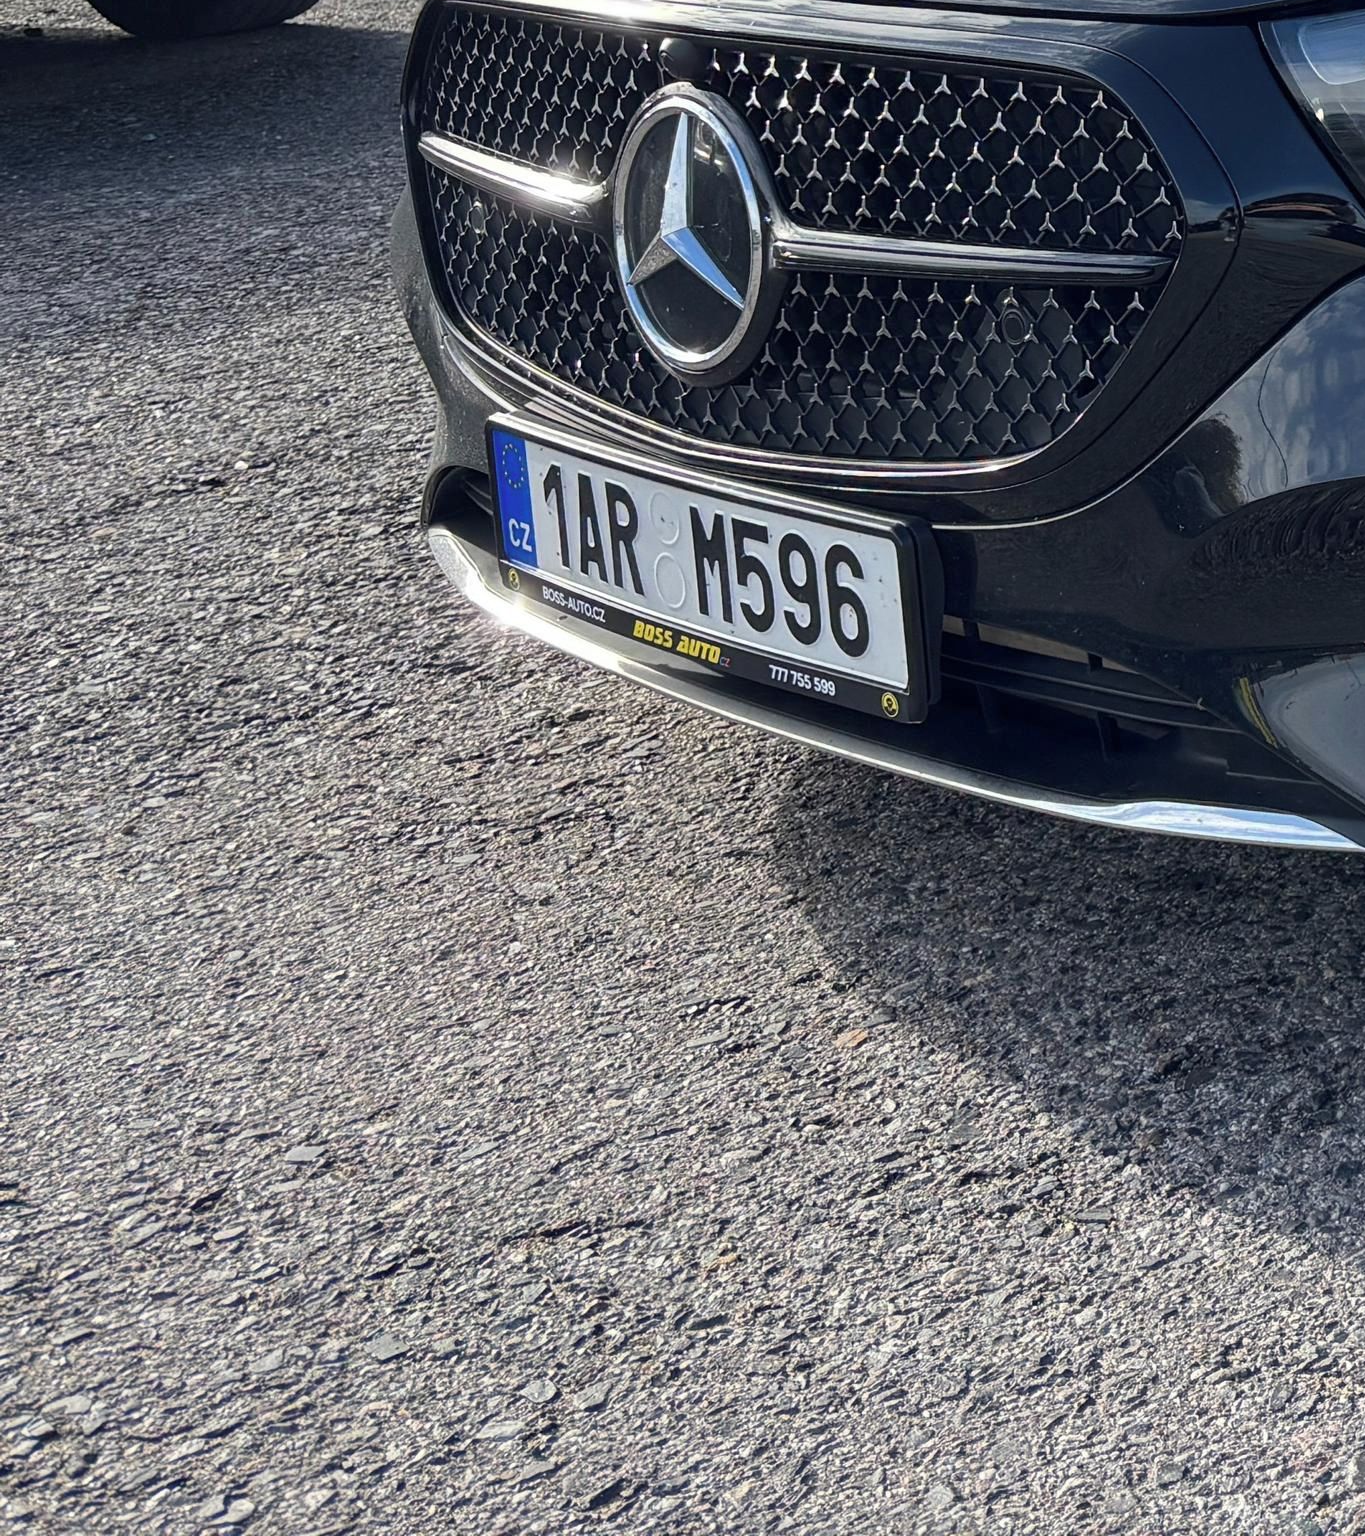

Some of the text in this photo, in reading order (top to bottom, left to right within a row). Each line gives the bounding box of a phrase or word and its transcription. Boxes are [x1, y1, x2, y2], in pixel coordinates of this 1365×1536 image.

[508, 518, 533, 553] CZ
[542, 463, 870, 658] 1AR M596
[542, 585, 606, 623] BOSS-AUTO.CZ
[633, 619, 673, 649] BOSS
[676, 635, 721, 664] AUTO
[768, 664, 836, 697] 777 755 599
